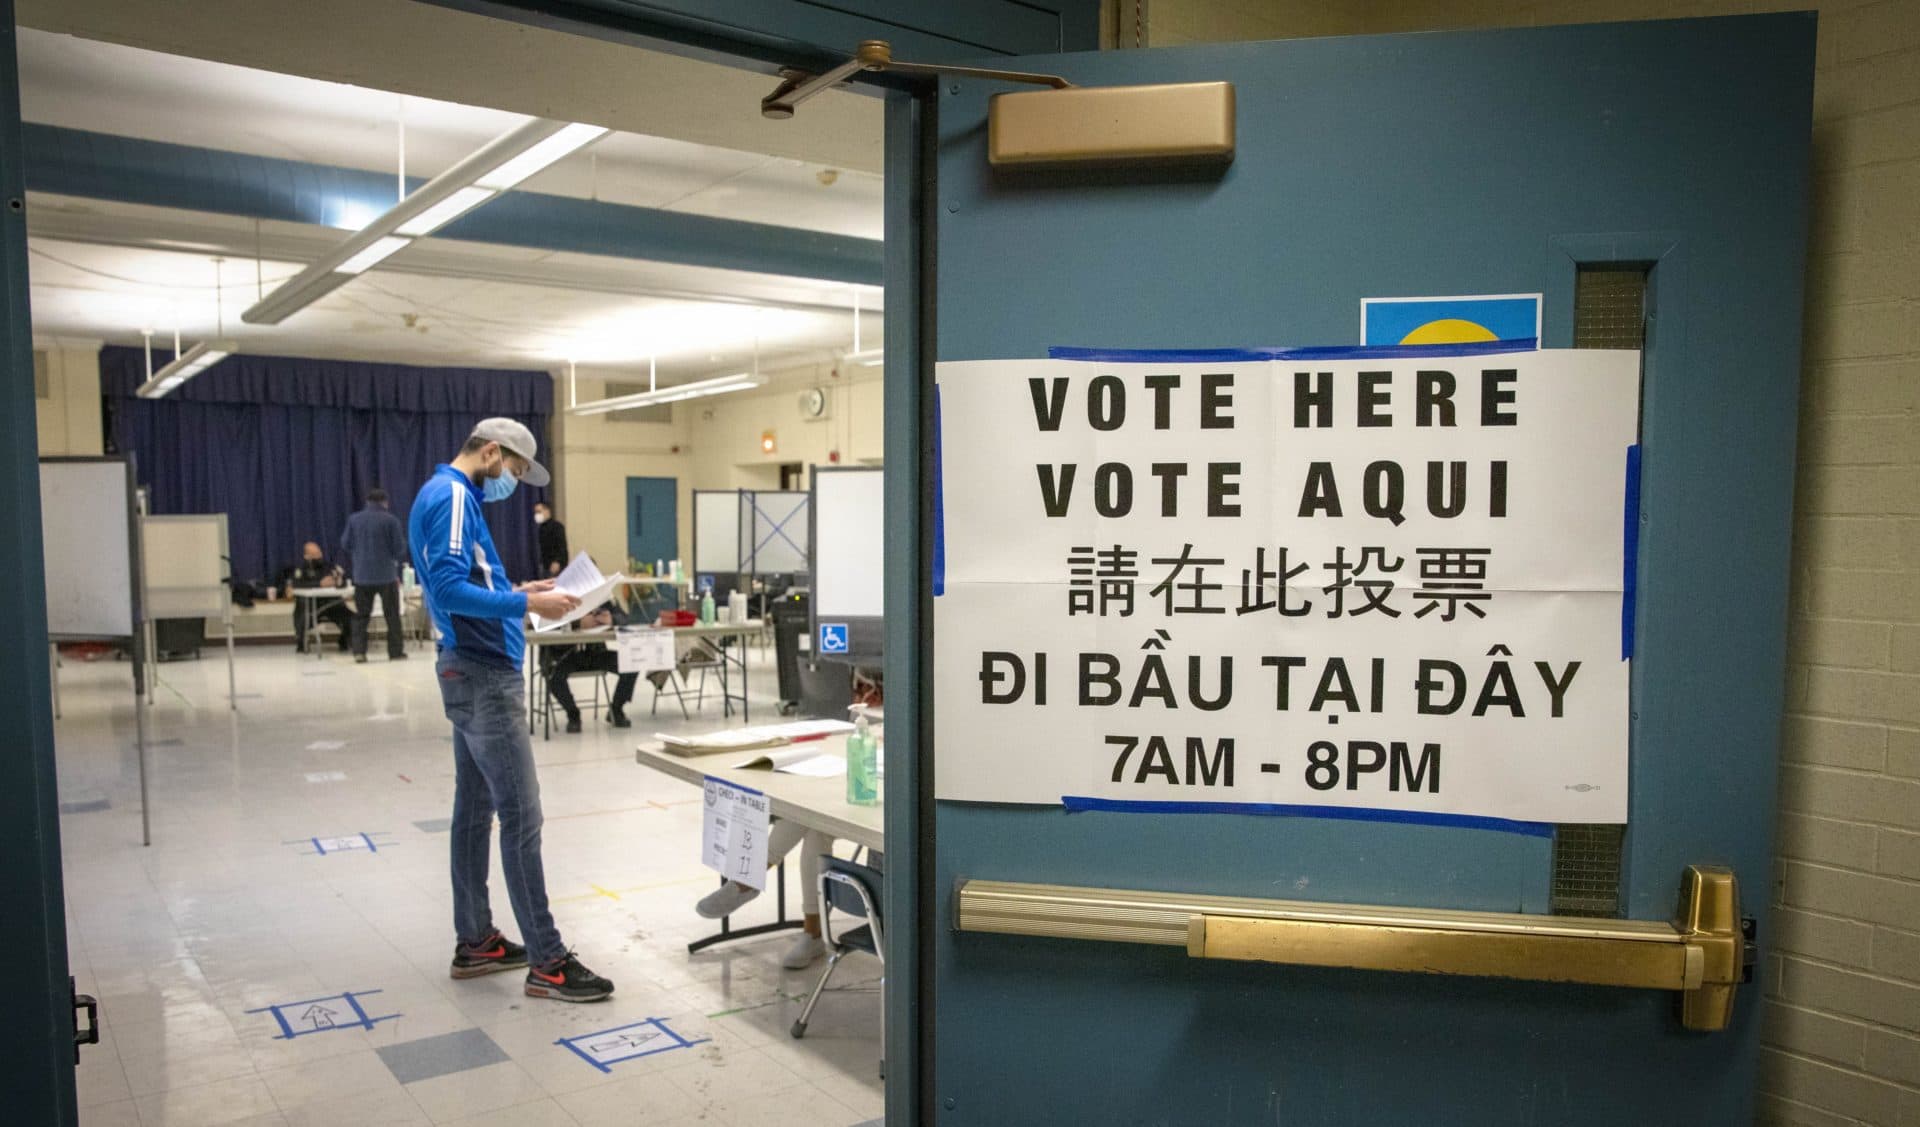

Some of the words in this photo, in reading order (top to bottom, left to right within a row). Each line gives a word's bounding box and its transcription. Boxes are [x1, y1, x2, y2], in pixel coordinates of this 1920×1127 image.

[1029, 373, 1235, 432] VOTE
[1293, 368, 1518, 428] HERE
[1036, 462, 1241, 518] VOTE
[1297, 460, 1508, 527] AQUI
[1067, 543, 1493, 622] 請在此投票
[978, 651, 1048, 706] ĐI
[1078, 629, 1233, 712] BẦU
[1261, 656, 1385, 725] TẠI
[1414, 644, 1582, 718] ĐÂY
[1104, 735, 1235, 787] 7AM
[1304, 740, 1441, 794] 8PM
